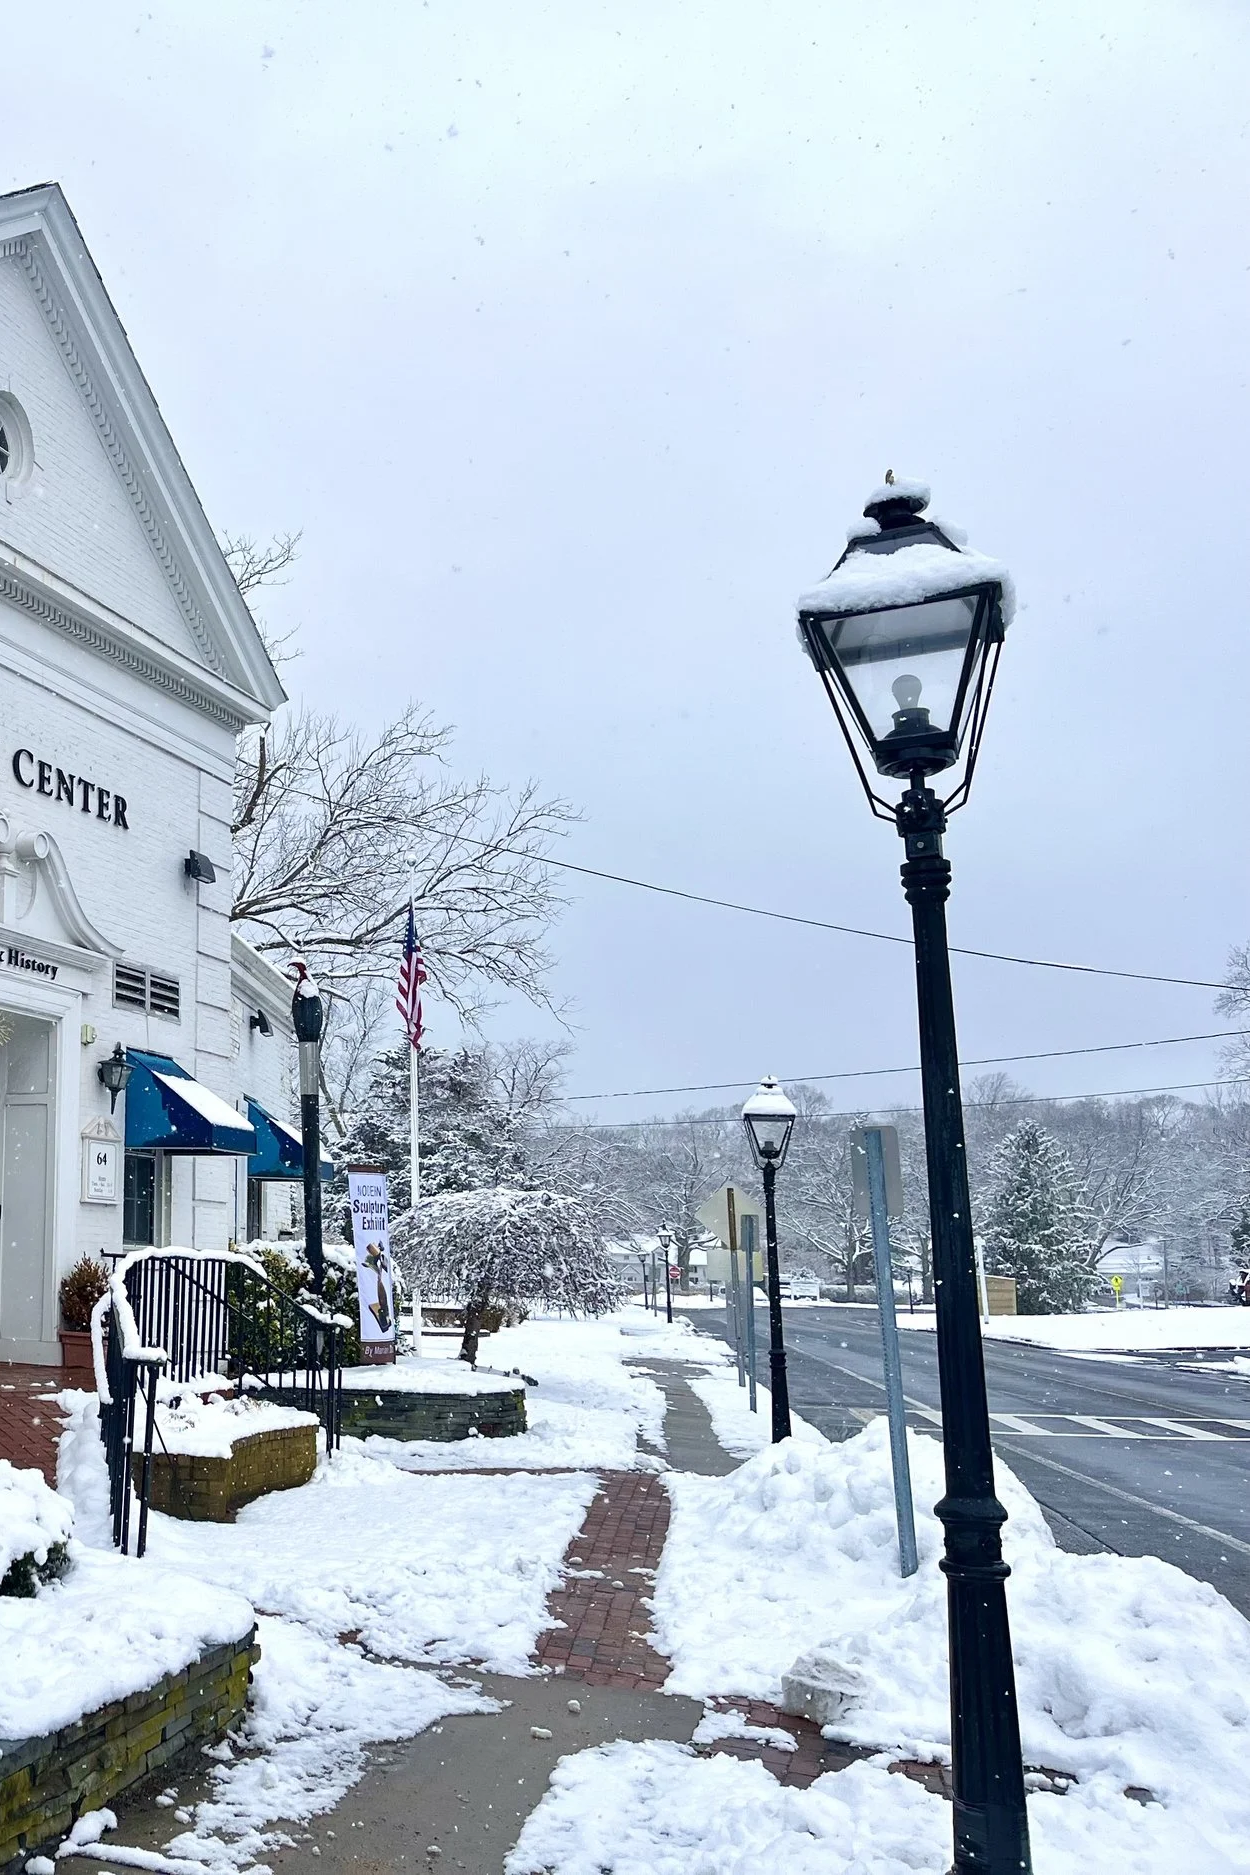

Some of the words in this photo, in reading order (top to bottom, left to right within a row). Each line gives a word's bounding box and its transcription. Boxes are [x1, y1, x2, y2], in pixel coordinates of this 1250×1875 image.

[12, 748, 130, 830] CENTER
[7, 948, 59, 980] History
[96, 1152, 107, 1165] 64
